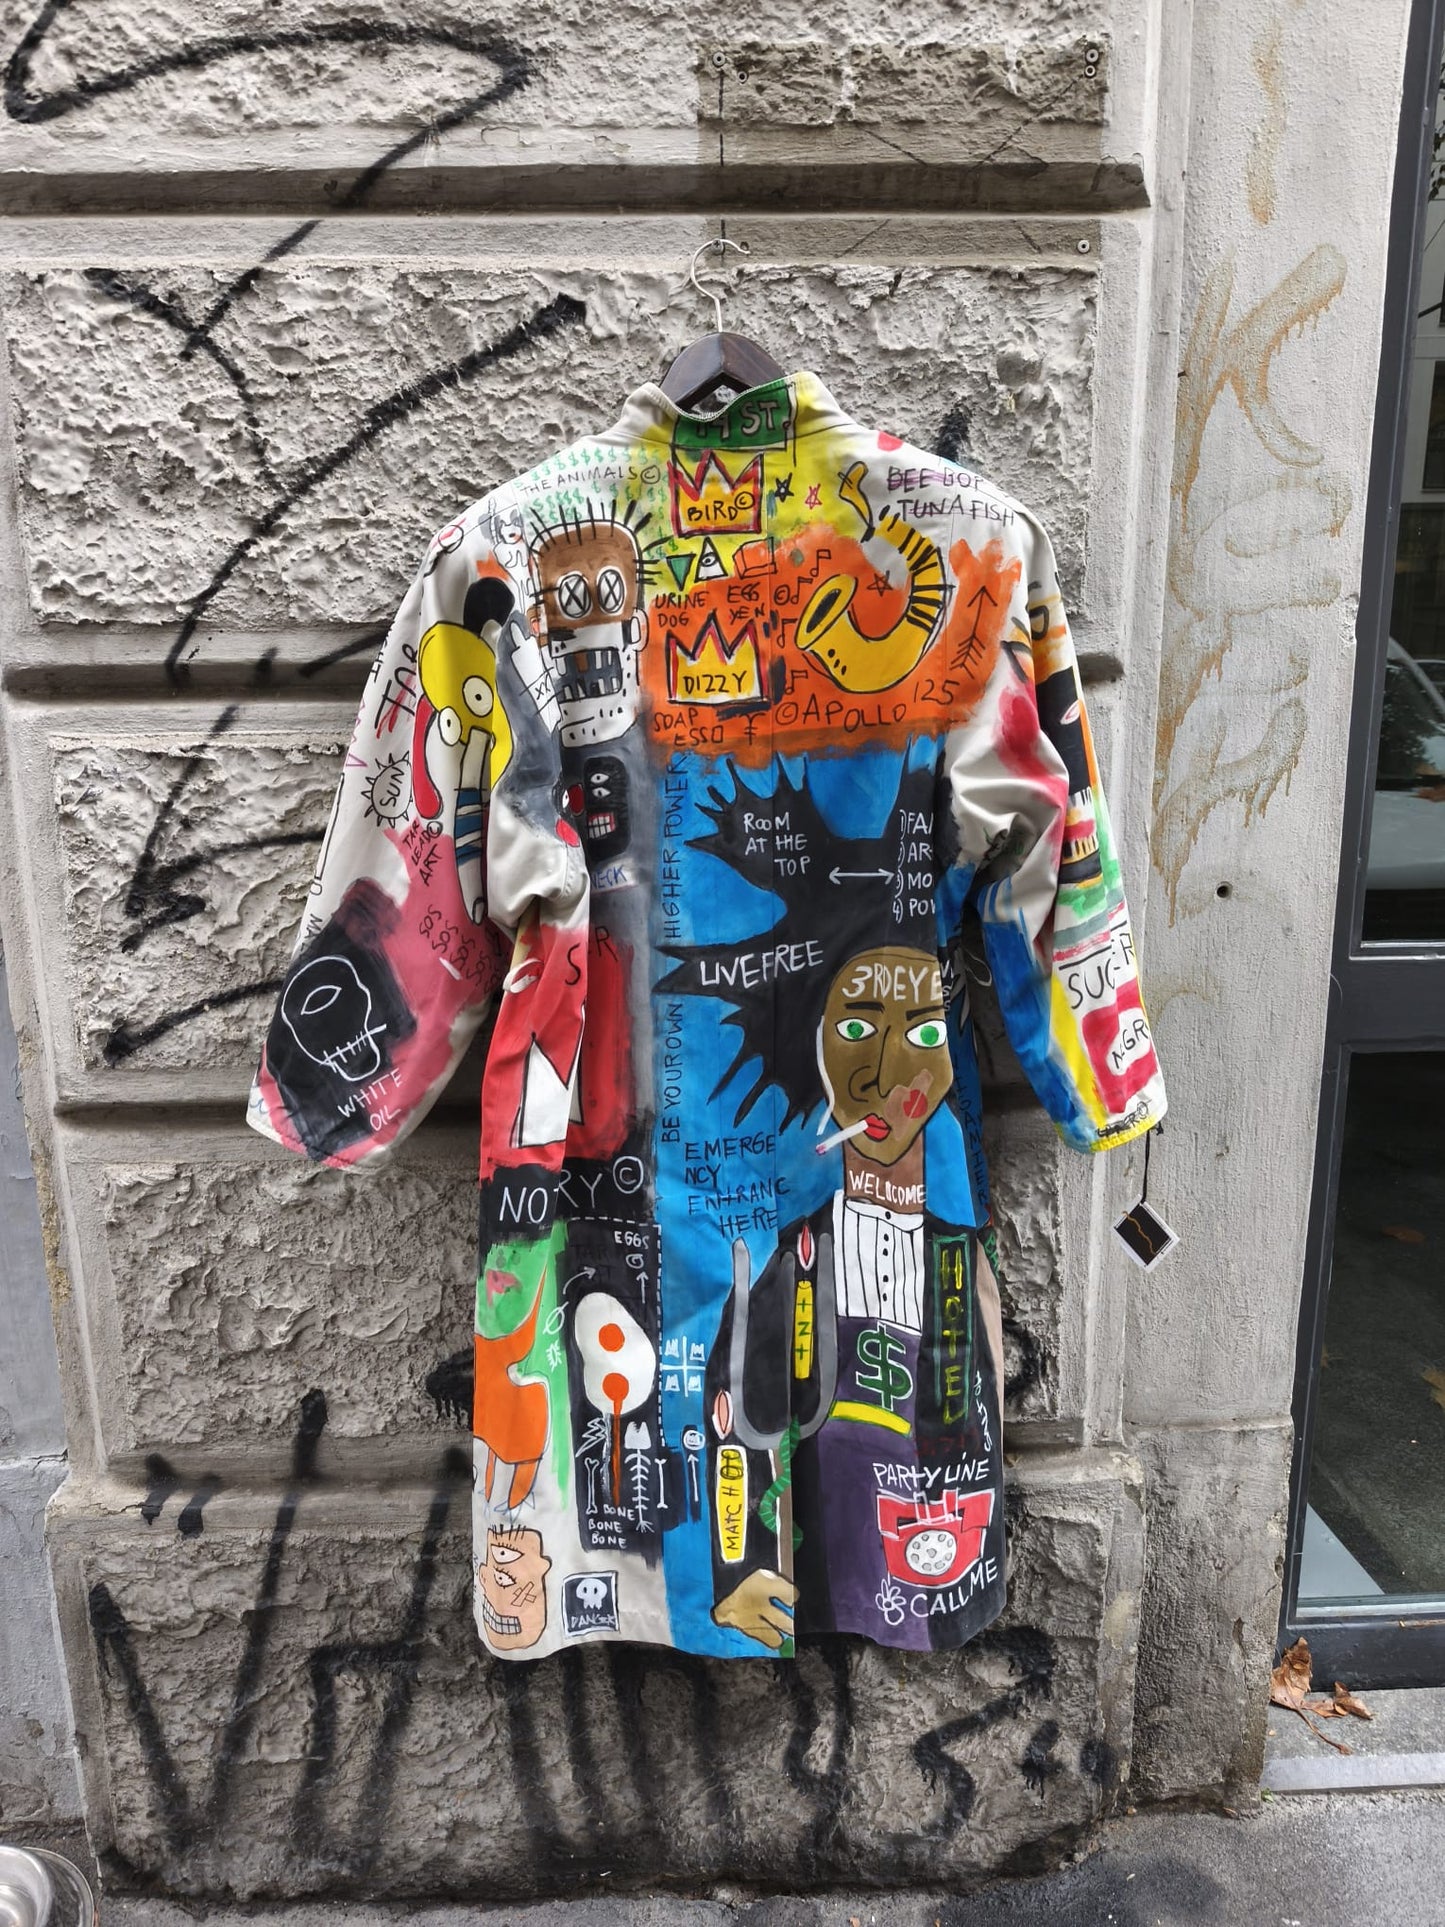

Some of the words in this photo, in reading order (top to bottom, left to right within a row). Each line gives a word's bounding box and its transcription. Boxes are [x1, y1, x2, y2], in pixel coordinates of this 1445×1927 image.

[520, 482, 552, 498] THE
[887, 466, 937, 493] BEE
[655, 590, 709, 609] URINE
[658, 613, 689, 628] DOG
[683, 671, 747, 694] DIZZY
[914, 679, 960, 705] 125
[380, 766, 405, 807] SUN
[744, 812, 791, 834] ROOM
[745, 837, 765, 855] AT
[419, 844, 442, 886] ART
[774, 855, 811, 877] TOP
[338, 1068, 402, 1118] WHITE
[370, 1106, 402, 1132] OIL
[662, 1116, 681, 1143] BE
[685, 1134, 776, 1161] EMERGE
[685, 1163, 721, 1188] NCY
[720, 1206, 778, 1239] HERE
[872, 1462, 942, 1489] PARTY
[603, 1504, 636, 1520] BONE
[588, 1519, 622, 1533] BONE
[591, 1533, 626, 1549] BONE
